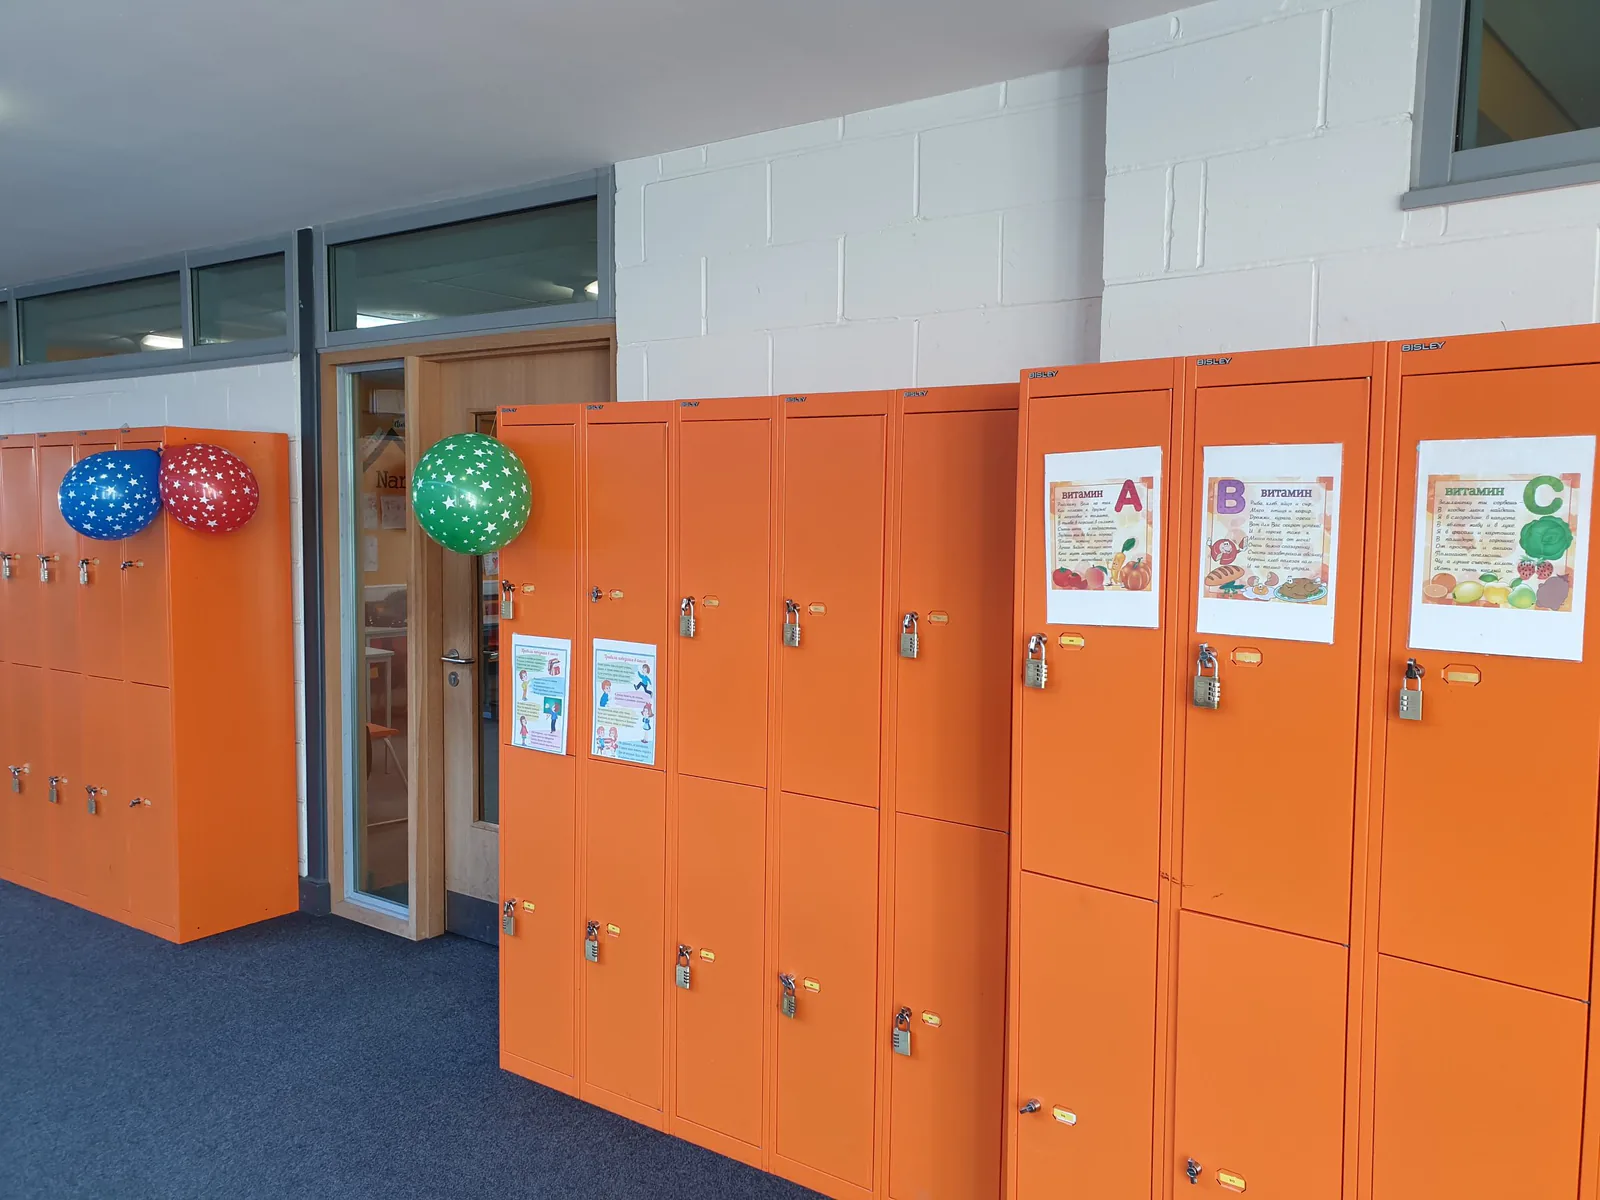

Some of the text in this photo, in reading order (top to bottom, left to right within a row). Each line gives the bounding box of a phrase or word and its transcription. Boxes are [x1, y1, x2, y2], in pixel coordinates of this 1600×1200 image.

[1402, 341, 1446, 352] BISLEY
[1197, 357, 1232, 366] BISLEY
[1029, 370, 1059, 379] BISLEY
